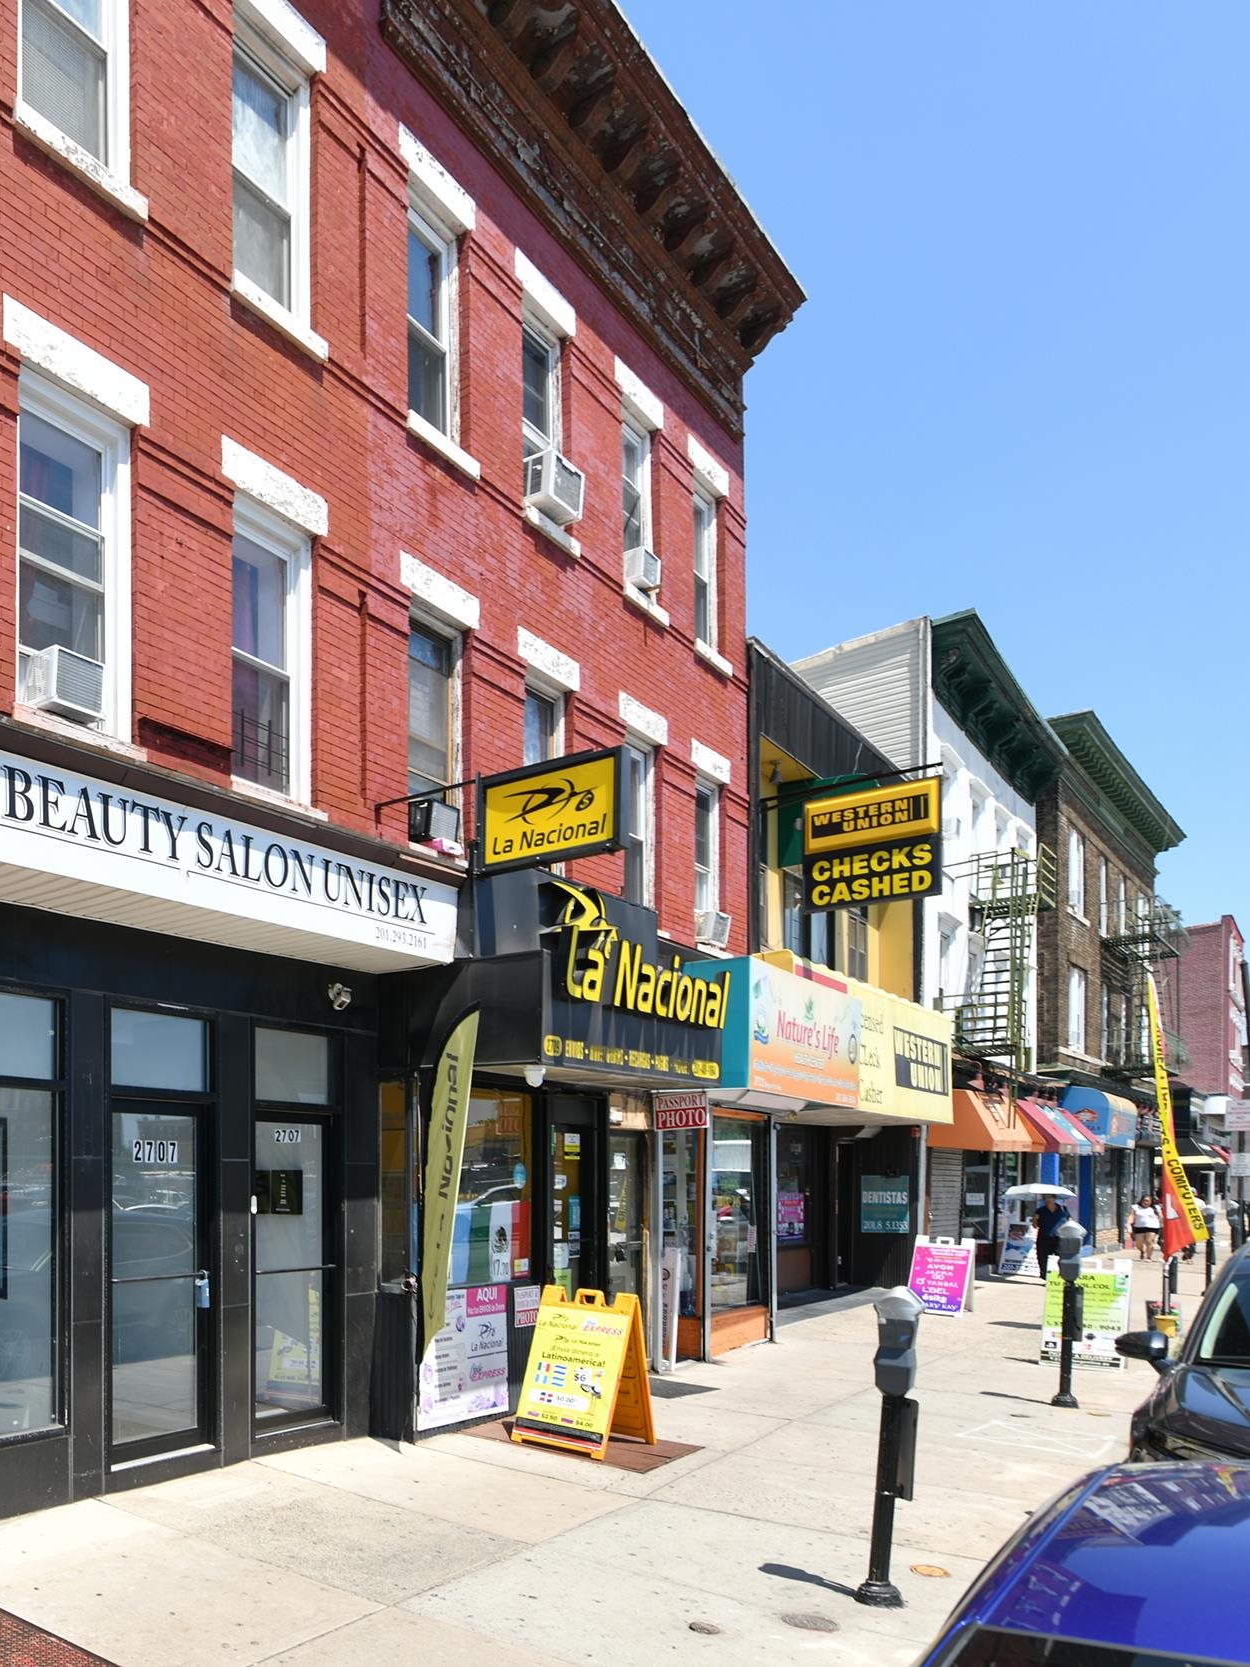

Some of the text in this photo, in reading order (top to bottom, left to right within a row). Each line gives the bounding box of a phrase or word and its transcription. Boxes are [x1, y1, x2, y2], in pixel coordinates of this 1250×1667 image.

[813, 799, 910, 826] WESTERN
[842, 811, 910, 832] UNION
[0, 763, 190, 862] BEAUTY
[195, 822, 317, 896] SALON
[322, 858, 430, 926] UNISEX
[493, 812, 607, 856] La Nacional
[812, 843, 933, 882] CHECKS
[812, 869, 933, 906] CASHED
[374, 925, 429, 950] 201.293.2161
[613, 937, 731, 1030] Nacional
[776, 1009, 841, 1060] Nature's Life
[655, 1095, 705, 1110] PASSPORT
[657, 1108, 706, 1128] PHOTO
[275, 1129, 301, 1143] 2707
[133, 1140, 178, 1163] 2707
[861, 1190, 909, 1204] DENTISTAS
[1167, 1159, 1204, 1230] COMPUTERS
